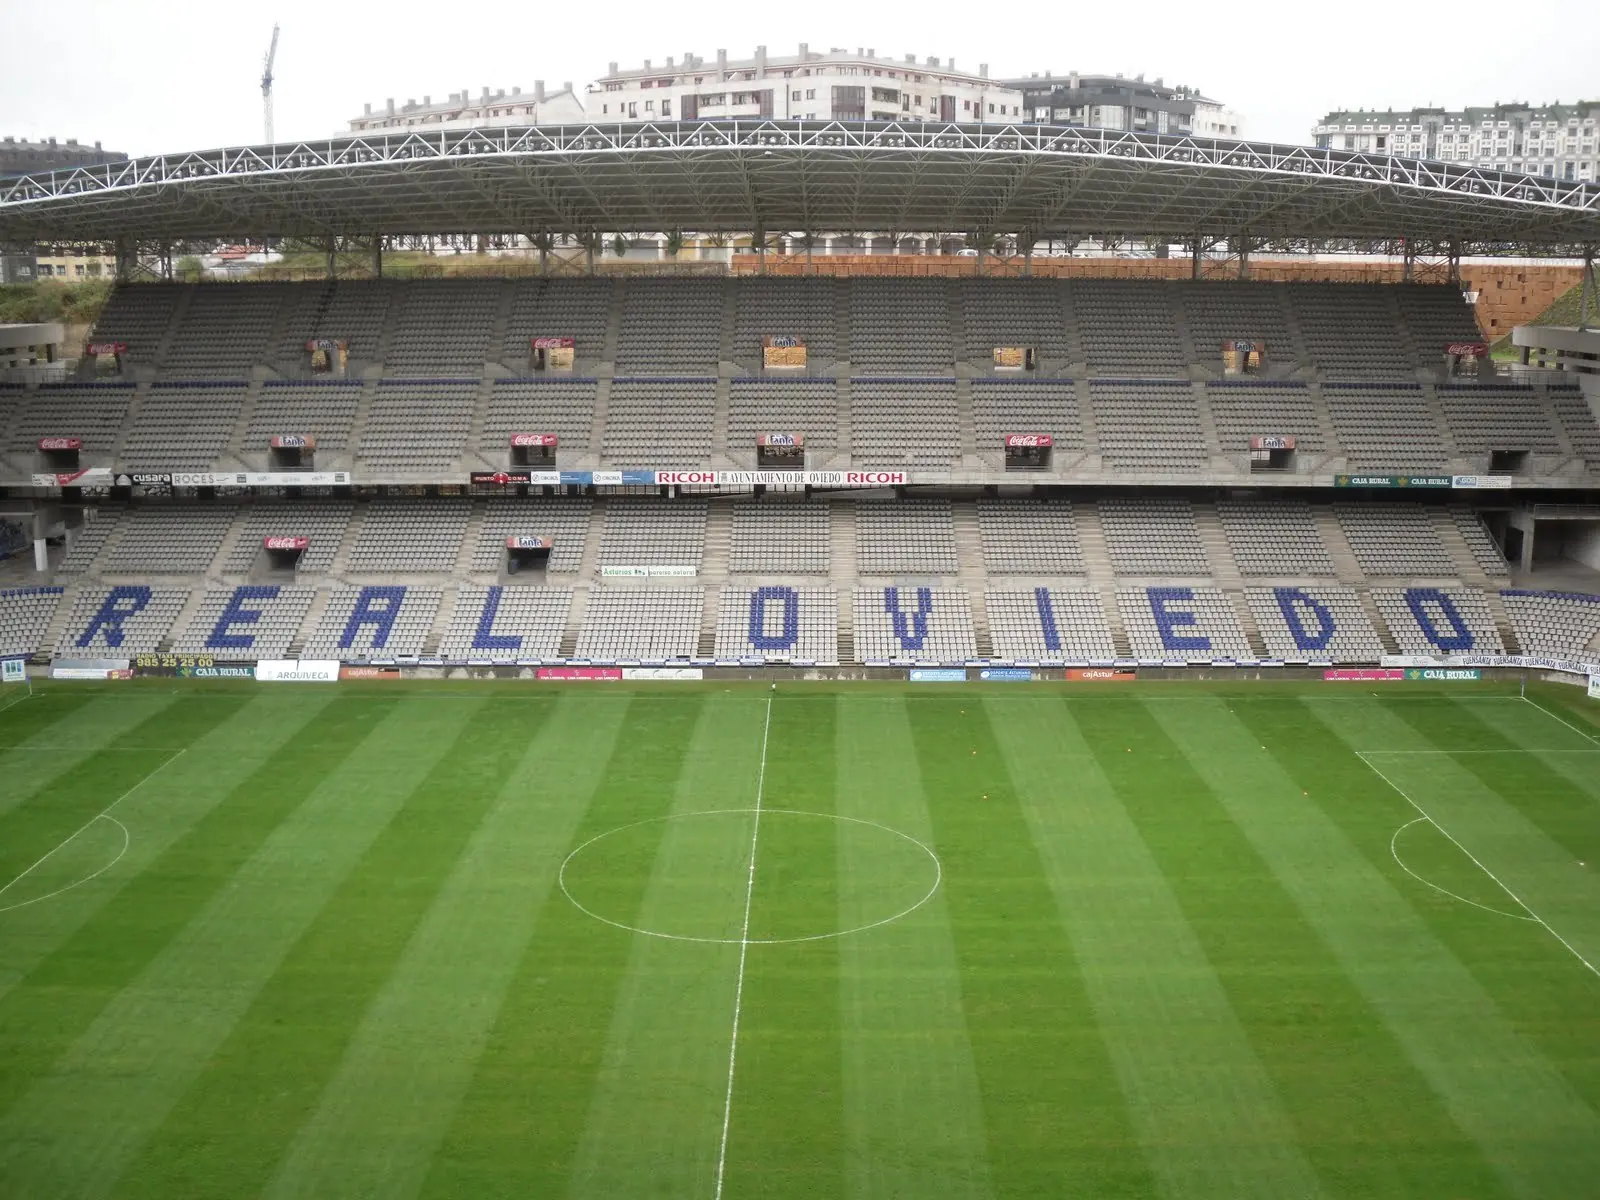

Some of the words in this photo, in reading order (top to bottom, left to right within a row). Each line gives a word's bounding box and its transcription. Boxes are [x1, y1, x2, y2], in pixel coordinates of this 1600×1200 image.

[133, 474, 170, 482] cusara
[174, 475, 215, 484] ROCES
[658, 473, 714, 483] RICOH
[730, 473, 793, 483] AYUNTAMIENTO
[795, 473, 805, 483] DE
[809, 473, 841, 483] OVIEDO
[847, 473, 903, 483] RICOH
[76, 586, 523, 649] REAL
[748, 586, 1476, 651] OVIEDO
[136, 659, 159, 667] 985
[162, 659, 177, 667] 25
[180, 659, 195, 667] 25
[198, 659, 214, 667] 00
[1463, 656, 1492, 666] FUENSANTA
[1494, 656, 1522, 666] FUENSANTA
[1525, 657, 1556, 669] FUENSANTA
[1558, 661, 1588, 674] FUENSANTA
[196, 668, 218, 677] CAJA
[220, 668, 251, 677] RURAL
[277, 671, 329, 680] ARQUIVECA
[1082, 670, 1113, 679] cajAstur
[1424, 670, 1446, 680] CAJA
[1447, 670, 1477, 680] RURAL
